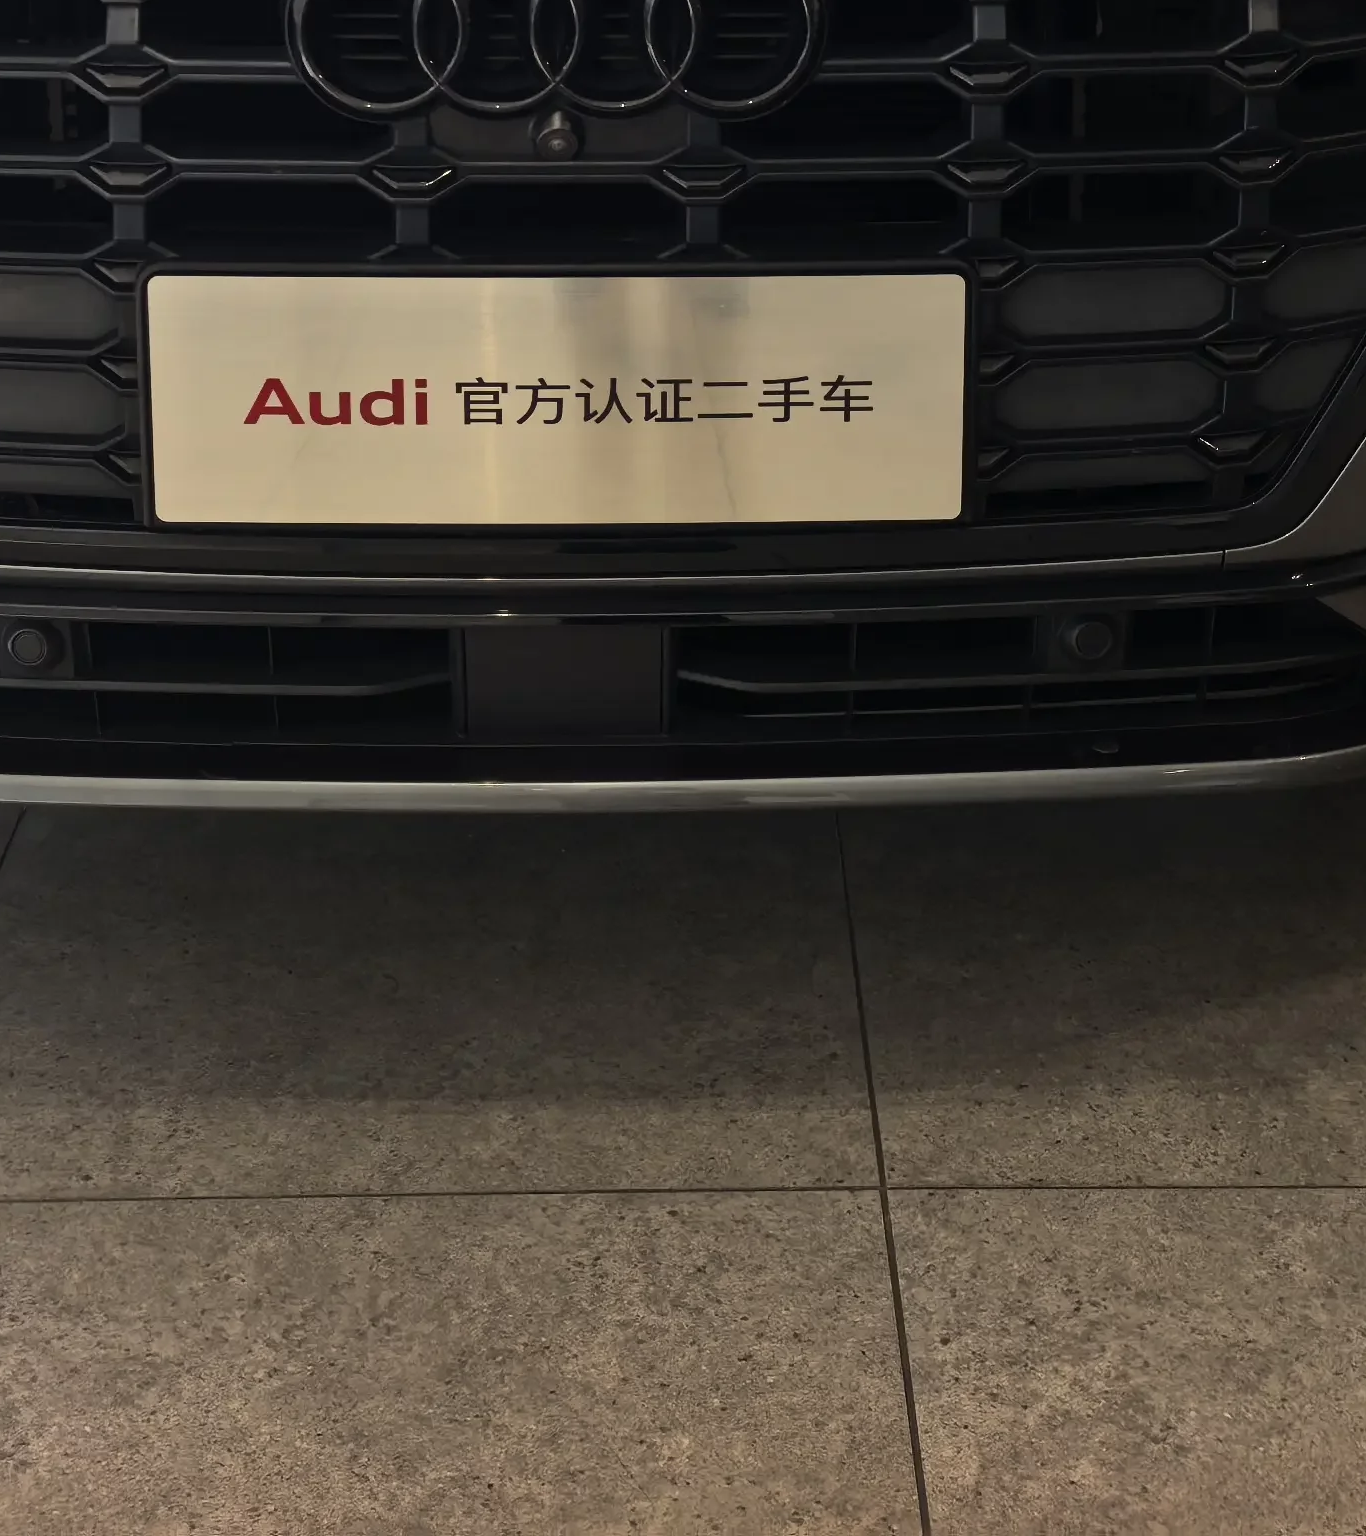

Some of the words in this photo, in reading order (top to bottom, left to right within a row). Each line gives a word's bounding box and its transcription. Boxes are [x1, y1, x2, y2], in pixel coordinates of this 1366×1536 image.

[244, 377, 428, 425] Audi
[455, 375, 875, 425] 官方认证二手车
